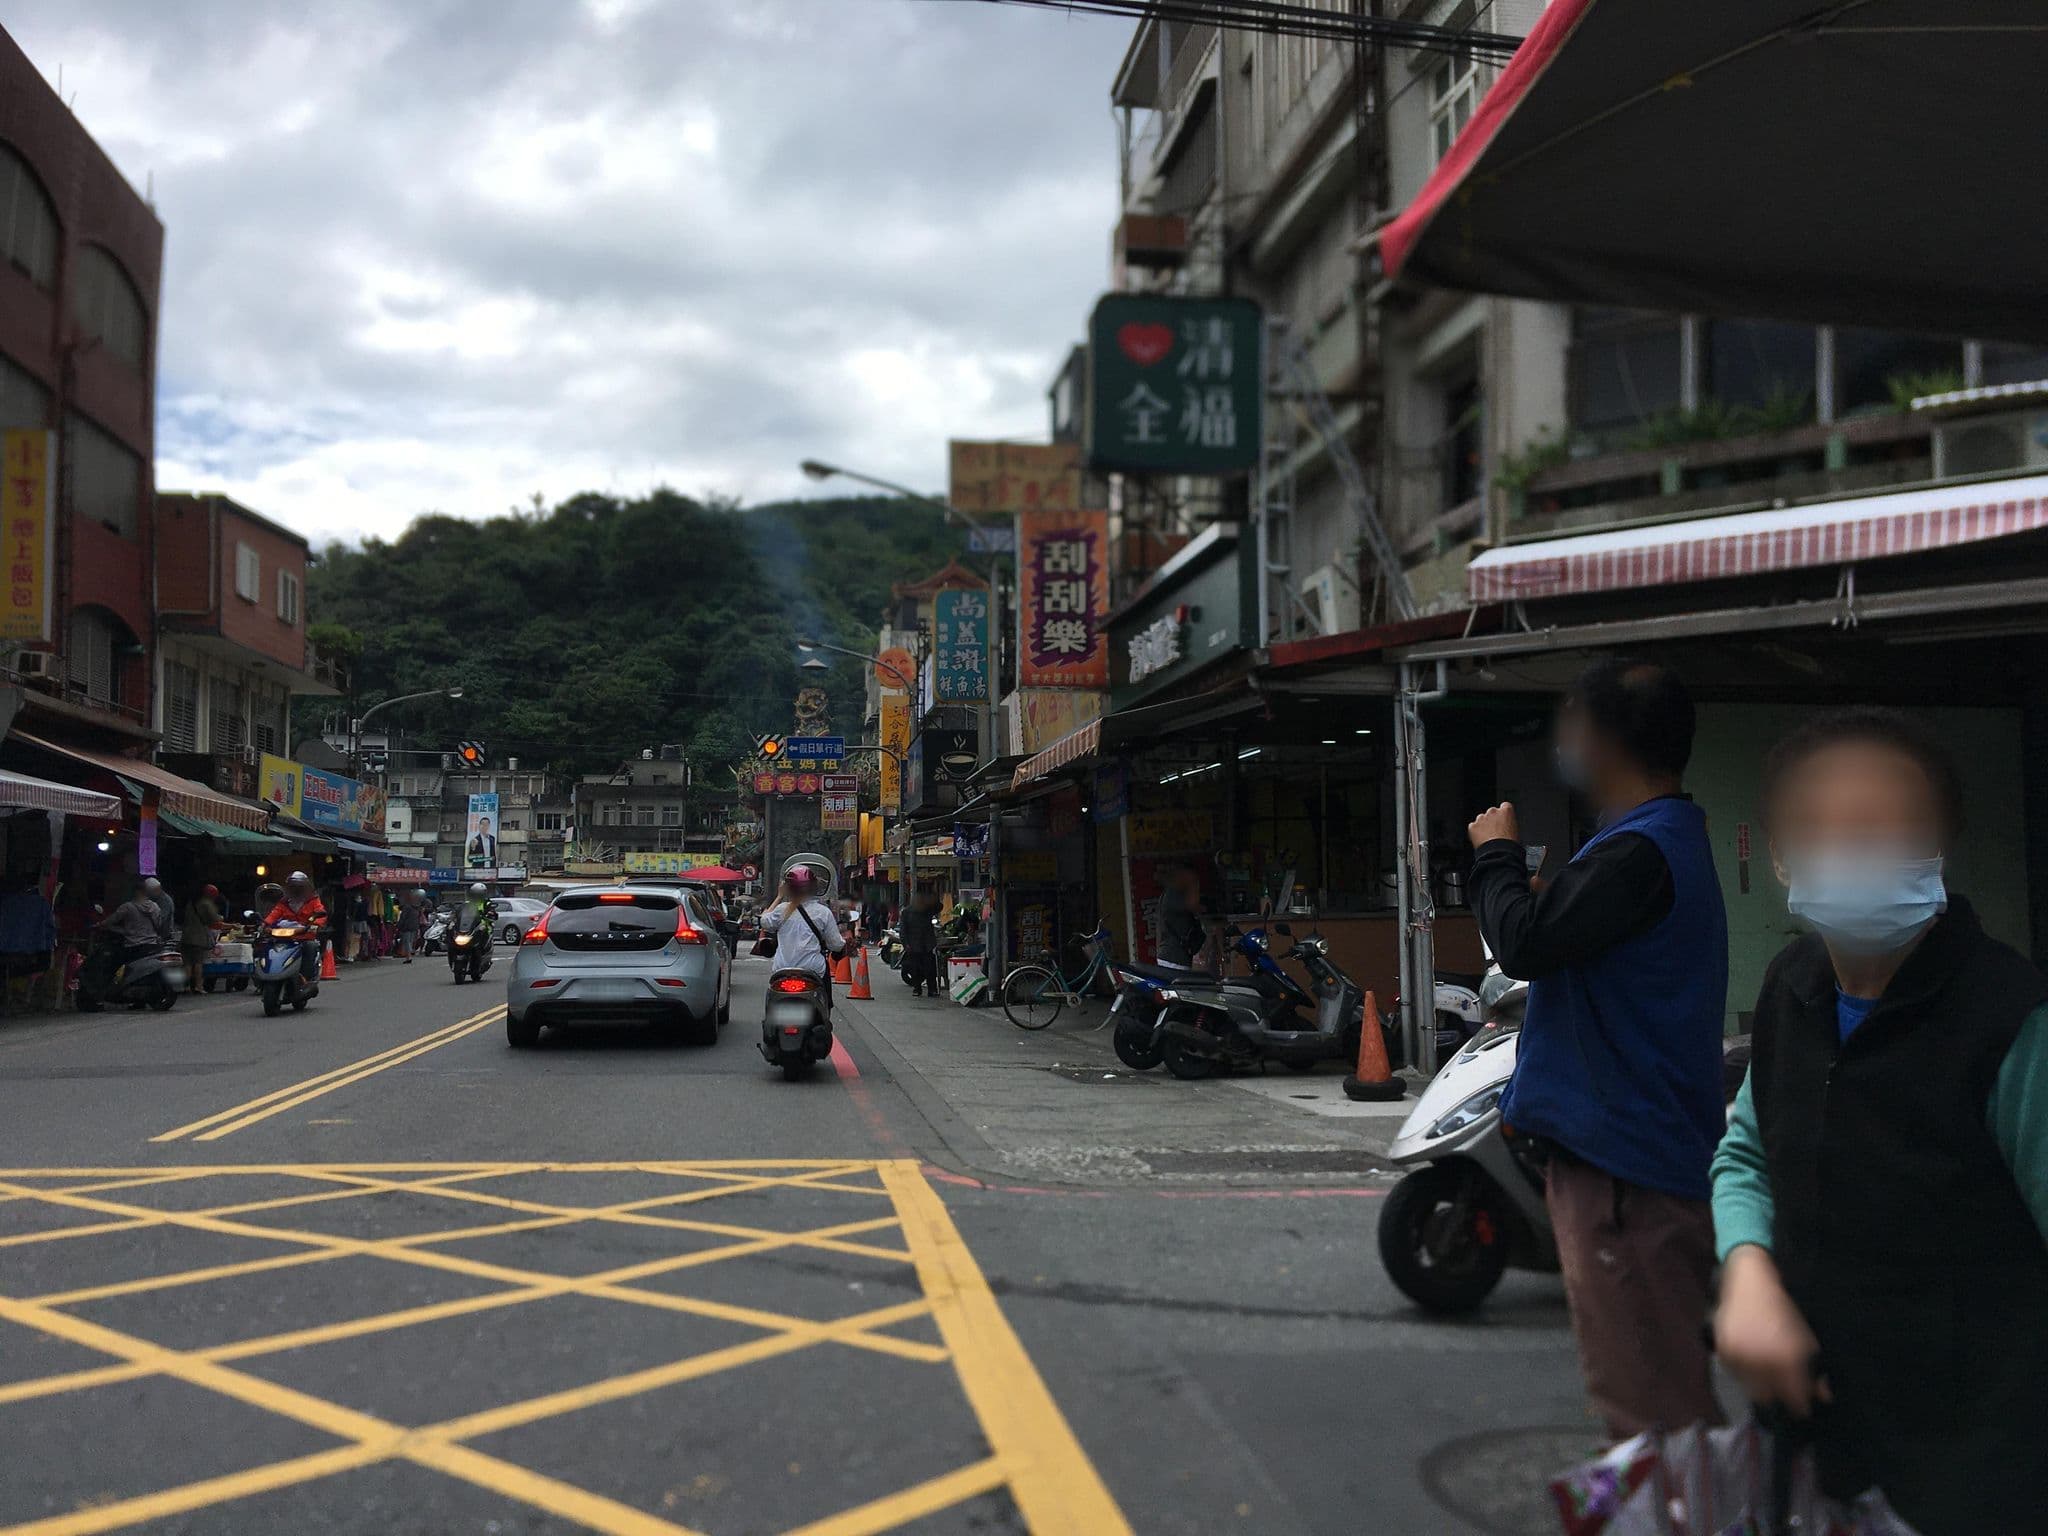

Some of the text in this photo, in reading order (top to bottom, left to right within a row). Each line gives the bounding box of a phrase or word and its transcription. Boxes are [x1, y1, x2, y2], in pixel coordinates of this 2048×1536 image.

[1042, 540, 1088, 653] 刮刮樂
[939, 675, 986, 697] 鮮魚湯
[799, 743, 844, 755] 假日單行道
[575, 932, 646, 940] VOLVO
